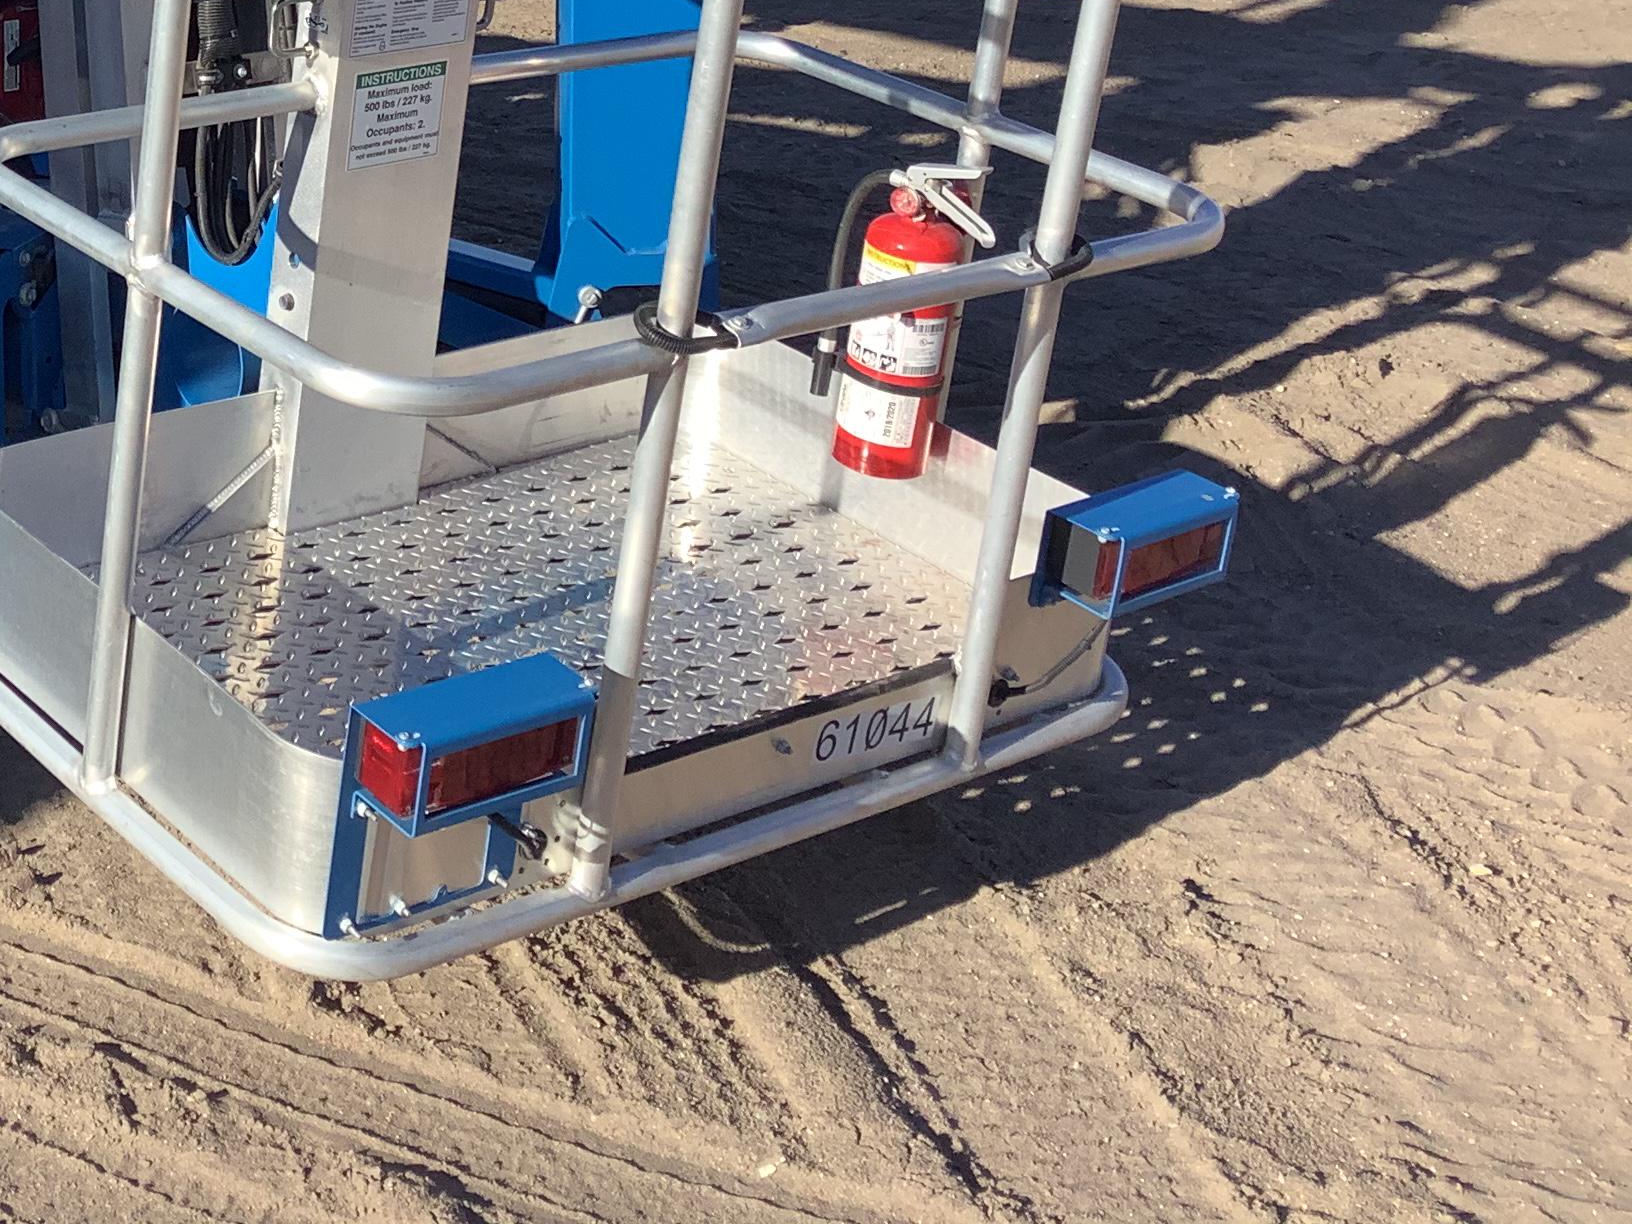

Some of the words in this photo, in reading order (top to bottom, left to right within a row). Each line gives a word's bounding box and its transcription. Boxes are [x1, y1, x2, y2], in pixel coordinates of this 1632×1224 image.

[361, 64, 442, 86] INSTRUCTIONS
[368, 86, 409, 99] Maximum
[411, 81, 432, 92] load:
[364, 102, 380, 112] 500
[402, 95, 418, 106] 227
[377, 110, 418, 122] Maximum
[815, 696, 935, 762] 61044
